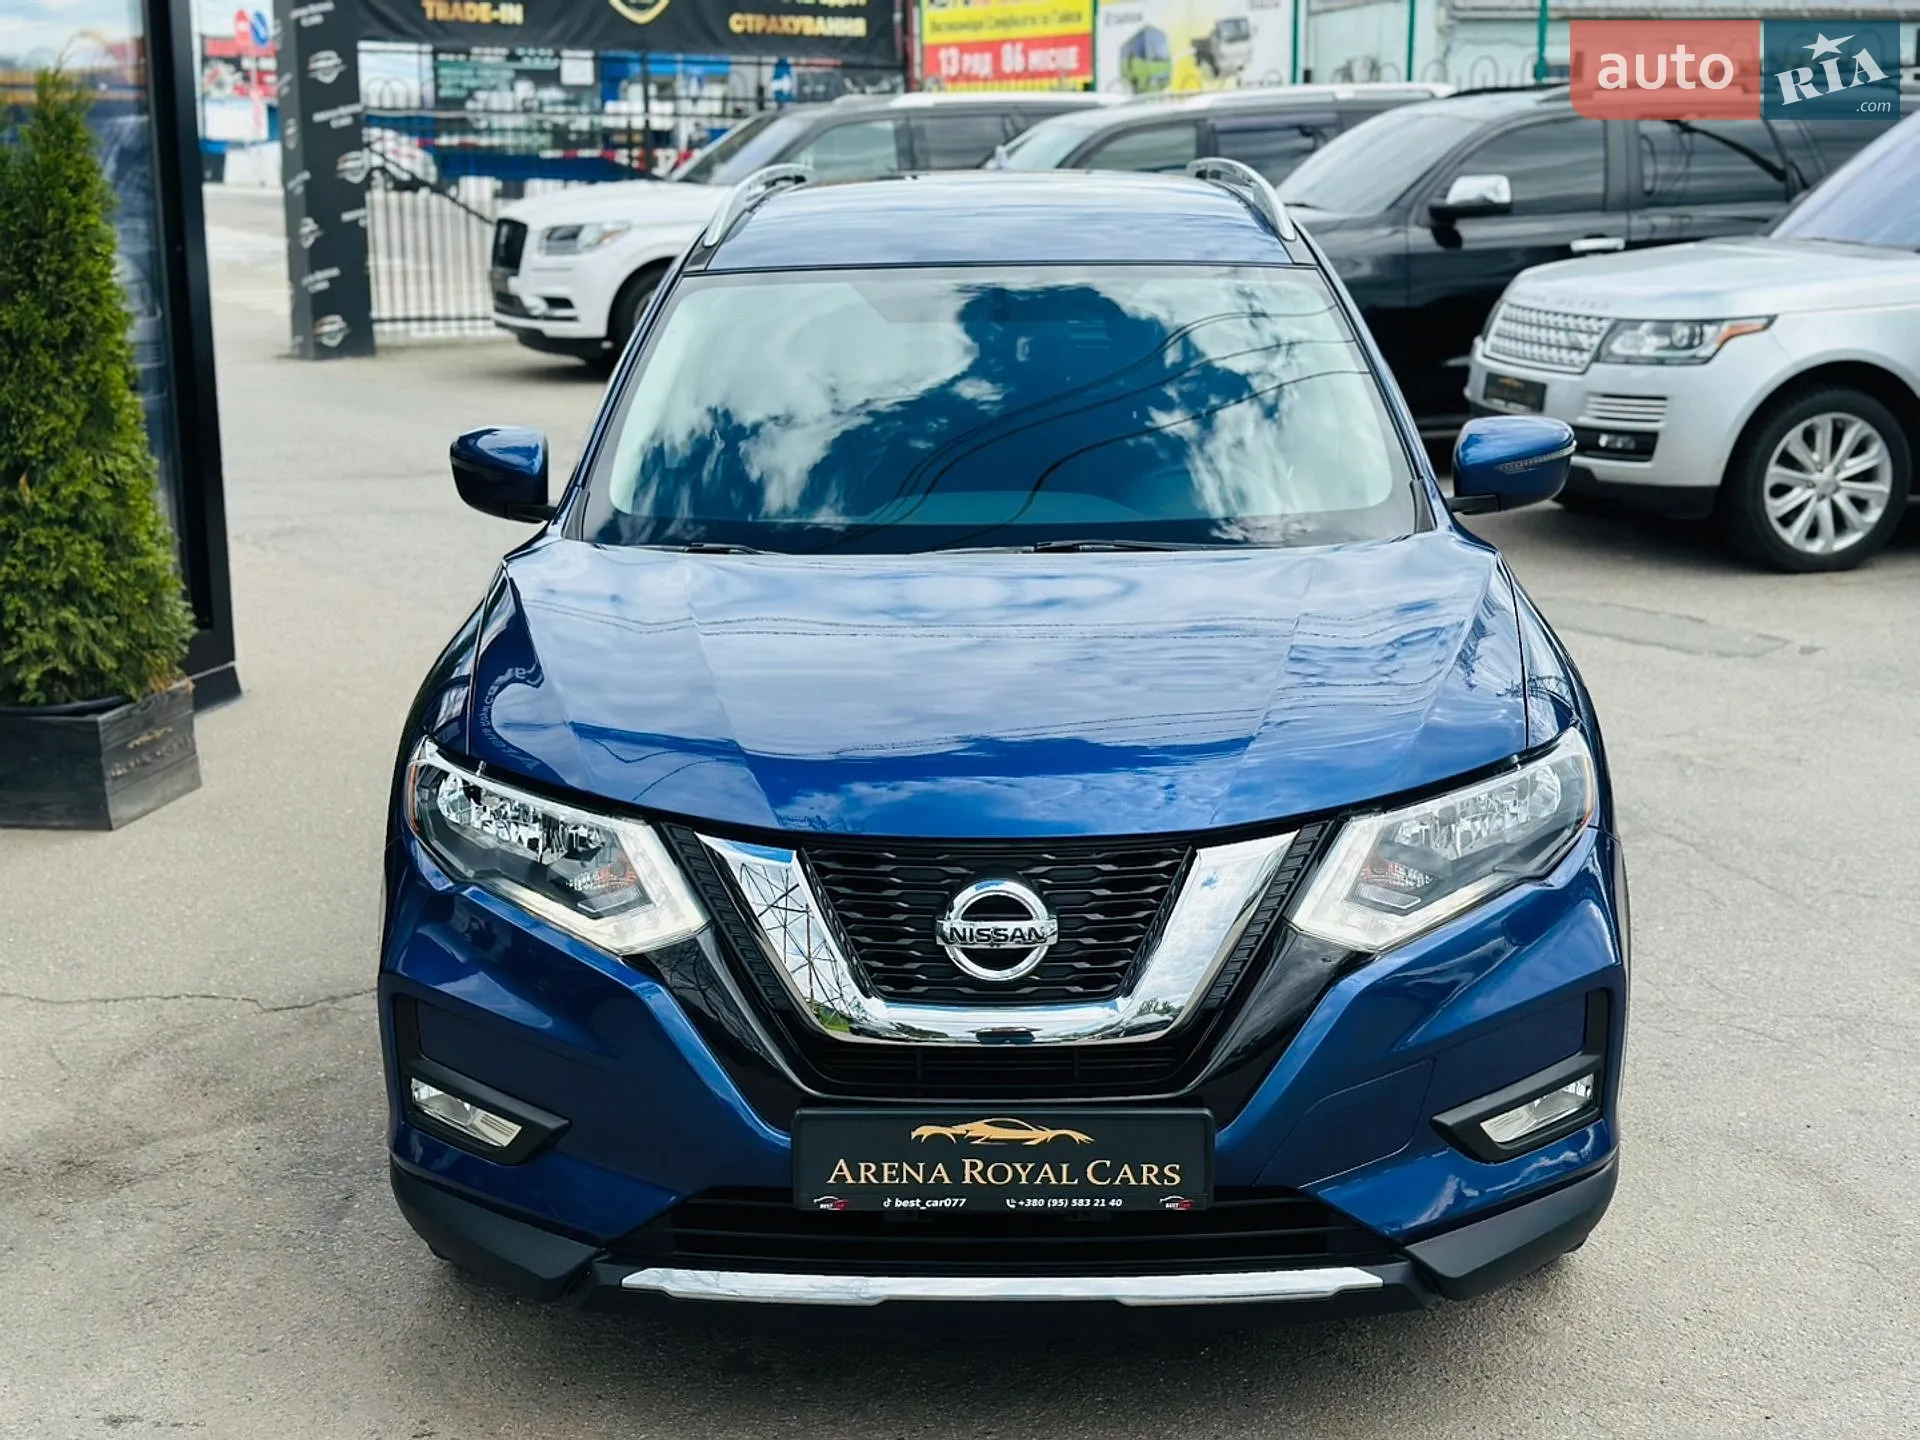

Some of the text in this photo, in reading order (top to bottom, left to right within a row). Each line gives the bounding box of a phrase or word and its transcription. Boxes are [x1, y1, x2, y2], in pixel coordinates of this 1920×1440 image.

[422, 1, 524, 25] TRADE-IN
[729, 13, 867, 37] СТРАХУВАННЯ
[938, 46, 960, 77] 13
[950, 926, 1047, 943] NISSAN
[827, 1158, 1182, 1186] ARENA ROYAL CARS
[894, 1198, 967, 1210] best_car077
[1018, 1198, 1123, 1208] +380 (95) 583 21 40
